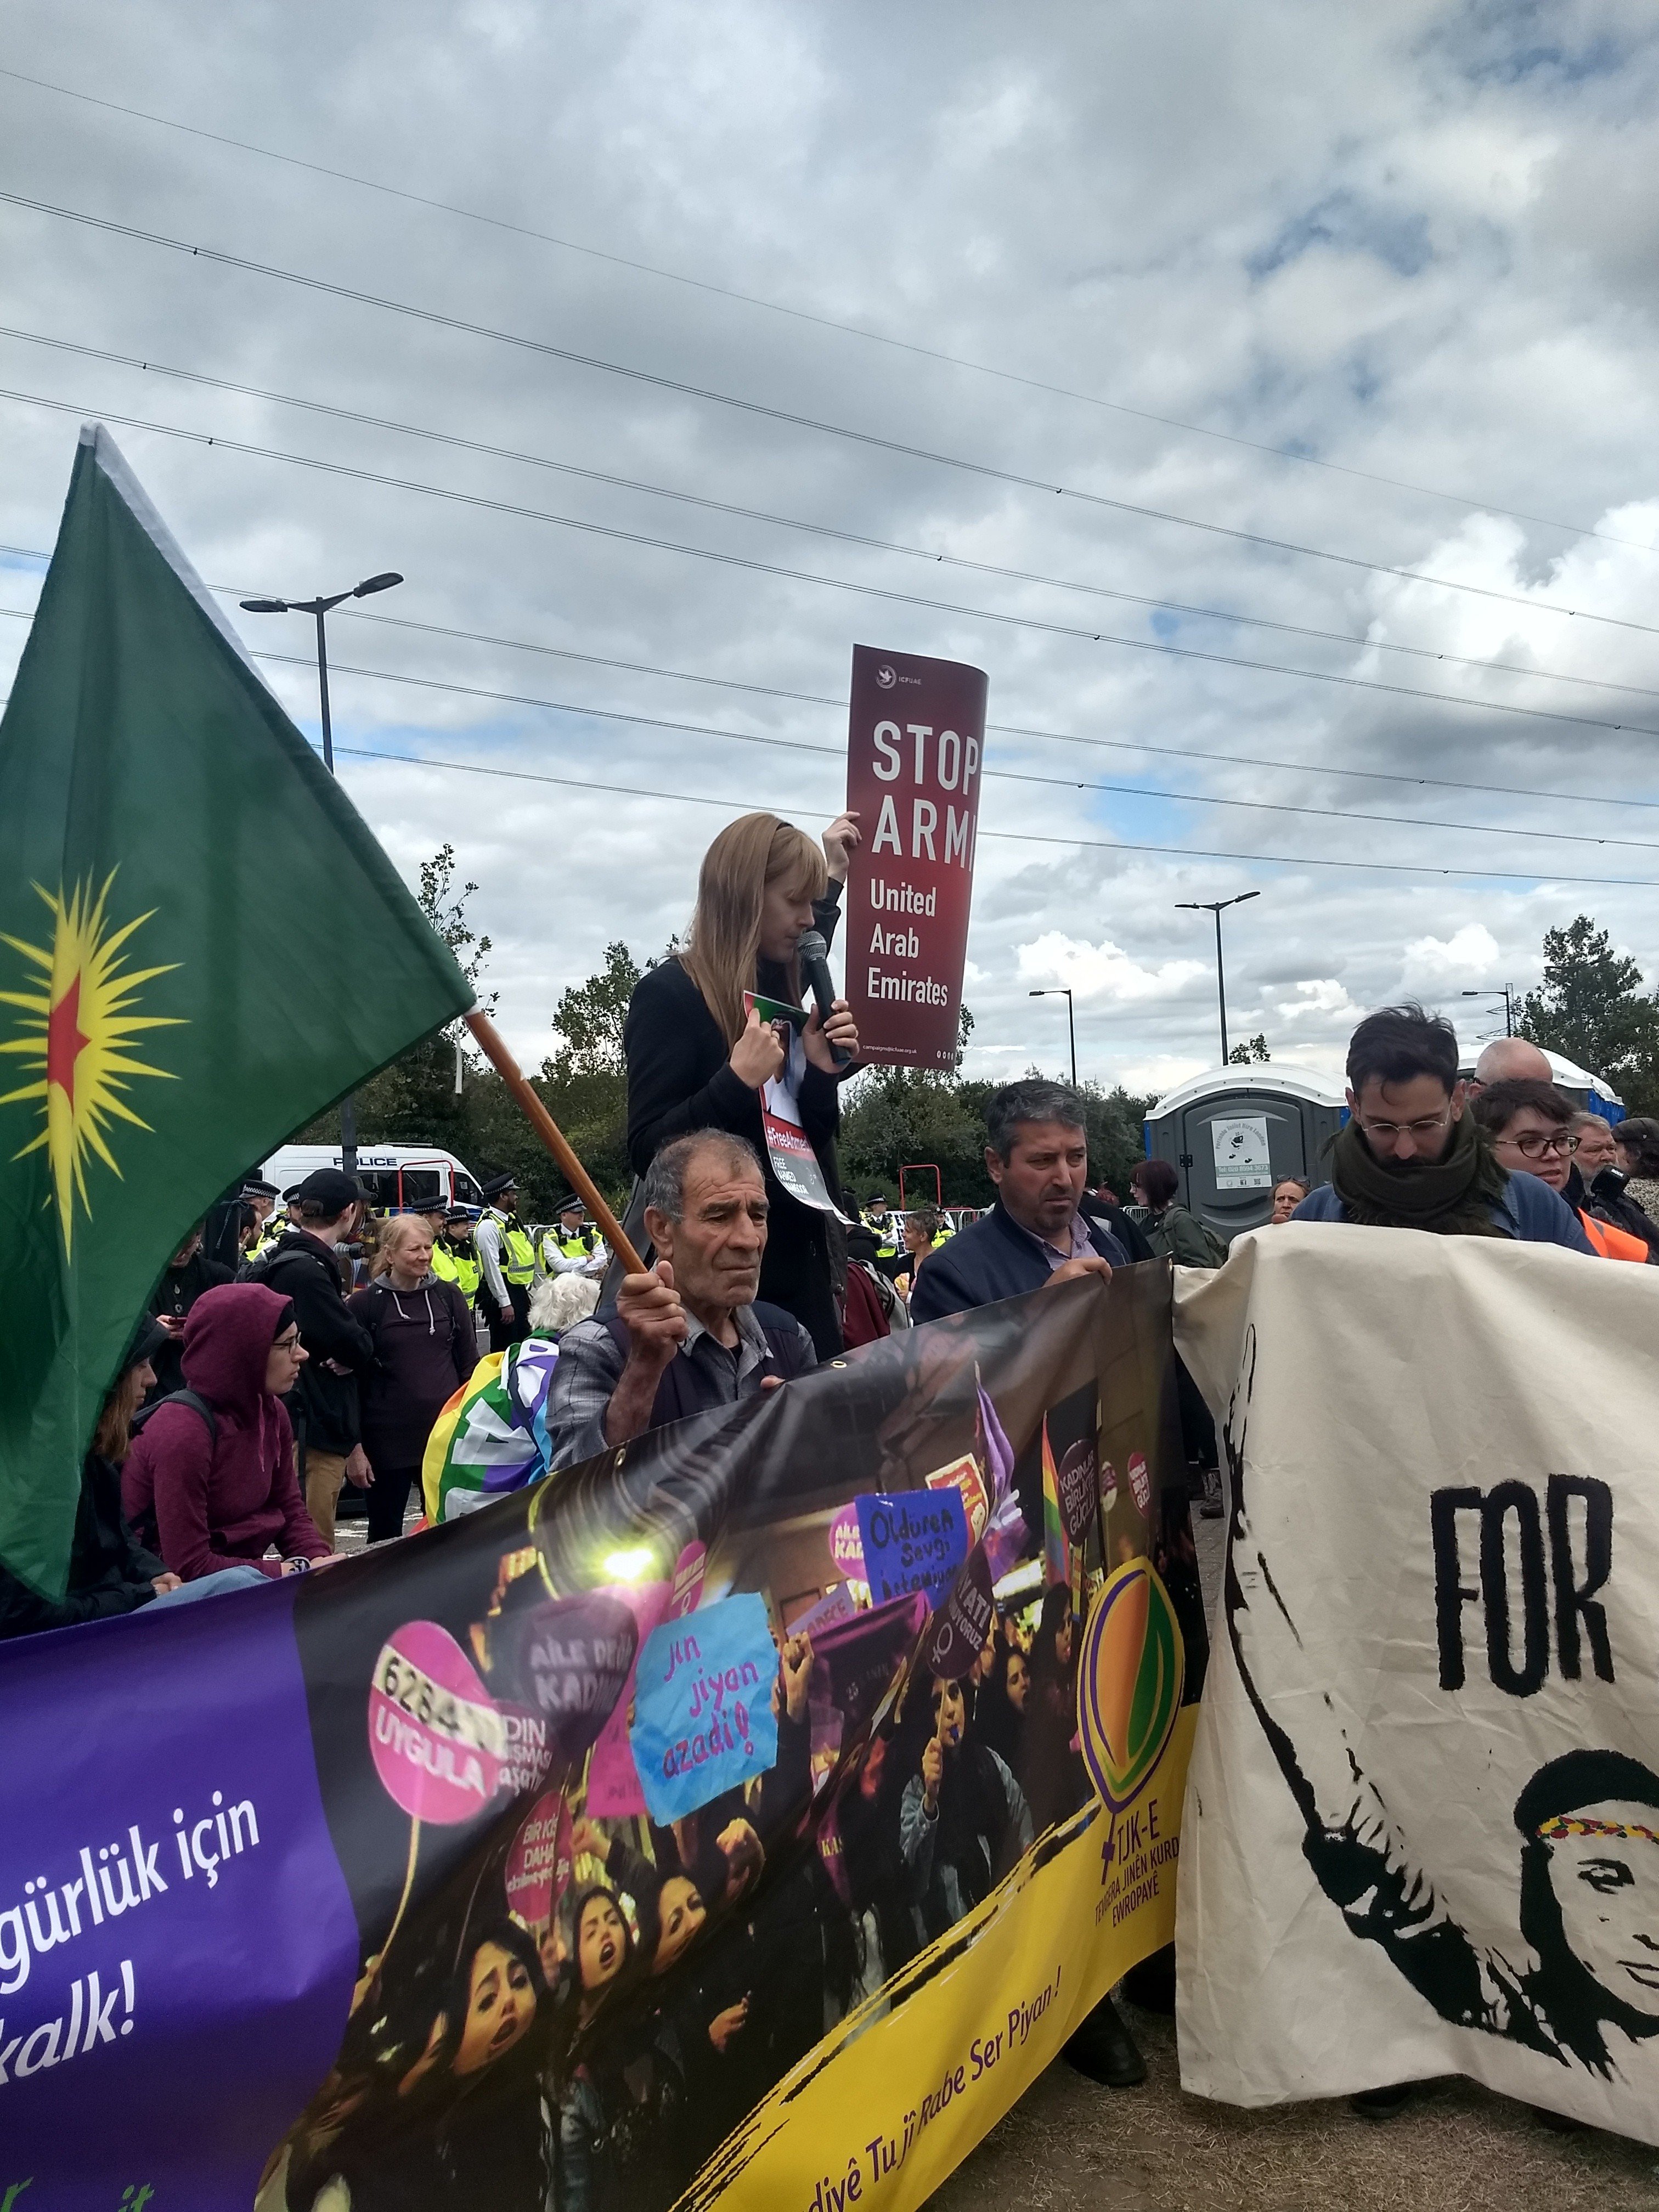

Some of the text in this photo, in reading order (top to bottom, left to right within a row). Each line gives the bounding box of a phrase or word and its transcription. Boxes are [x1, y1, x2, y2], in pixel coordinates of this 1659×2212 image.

[872, 720, 978, 795] STOP
[870, 878, 937, 917] United
[869, 923, 919, 958] Arab
[867, 967, 948, 1007] Emirates
[773, 1156, 787, 1170] FREE
[1431, 1472, 1615, 1698] FOR
[173, 1791, 260, 1889] için
[1117, 1798, 1160, 1865] TJK-E
[0, 1825, 168, 1995] gürlük
[1112, 1870, 1160, 1928] EWROPAYÊ
[865, 2135, 896, 2183] Tu
[918, 2065, 966, 2135] Rabe
[970, 2031, 1003, 2081] Ser
